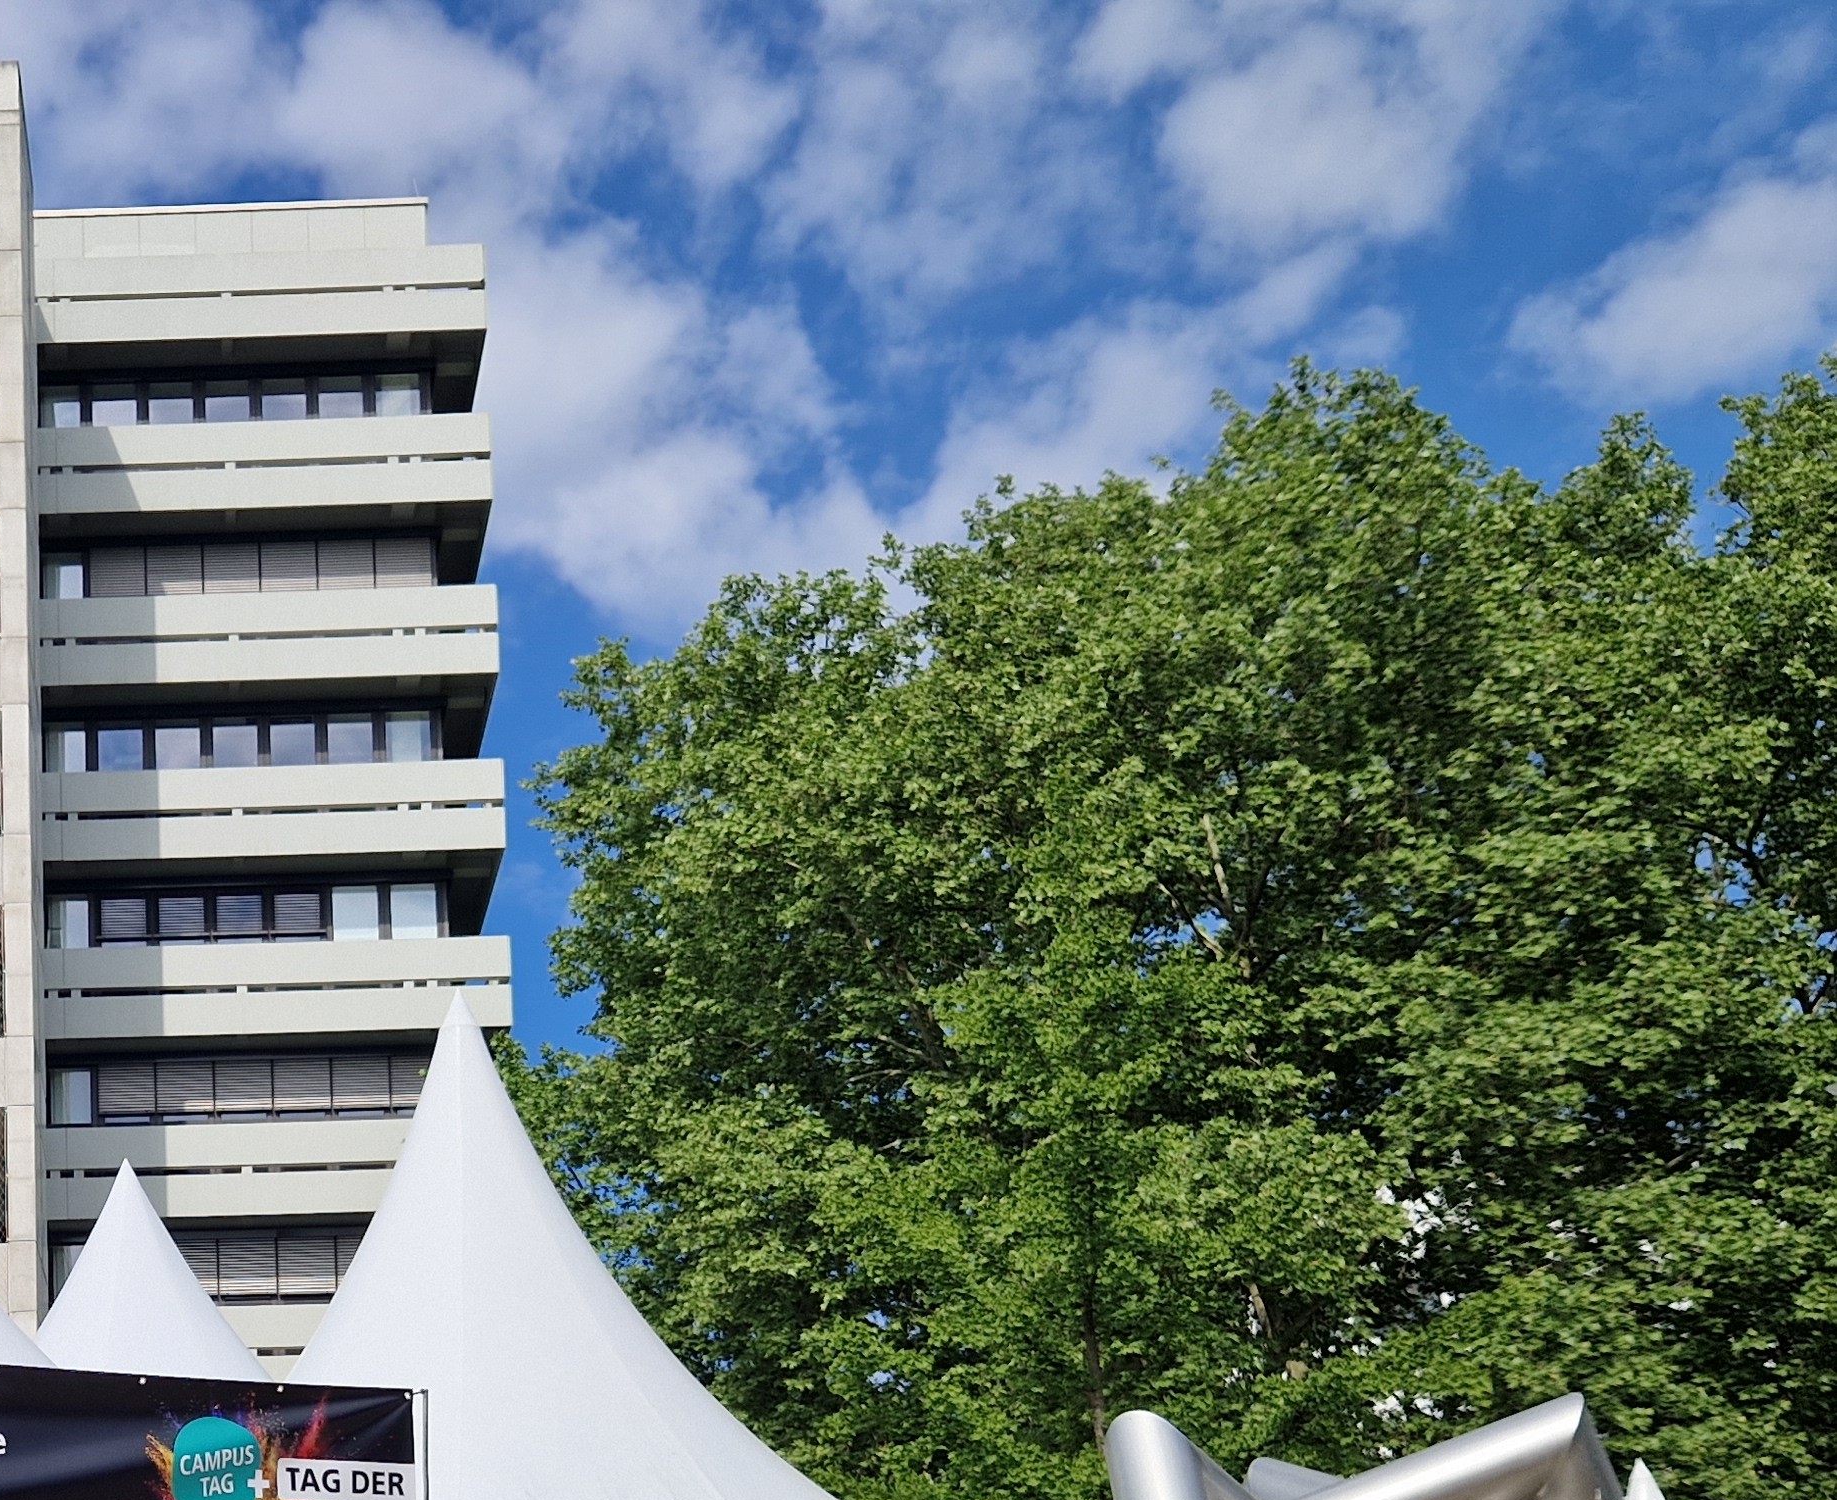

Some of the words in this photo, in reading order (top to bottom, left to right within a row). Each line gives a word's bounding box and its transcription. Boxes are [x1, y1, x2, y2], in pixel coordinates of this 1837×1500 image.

[180, 1445, 254, 1476] CAMPUS
[200, 1473, 234, 1498] TAG
[286, 1467, 340, 1493] TAG
[352, 1470, 404, 1496] DER
